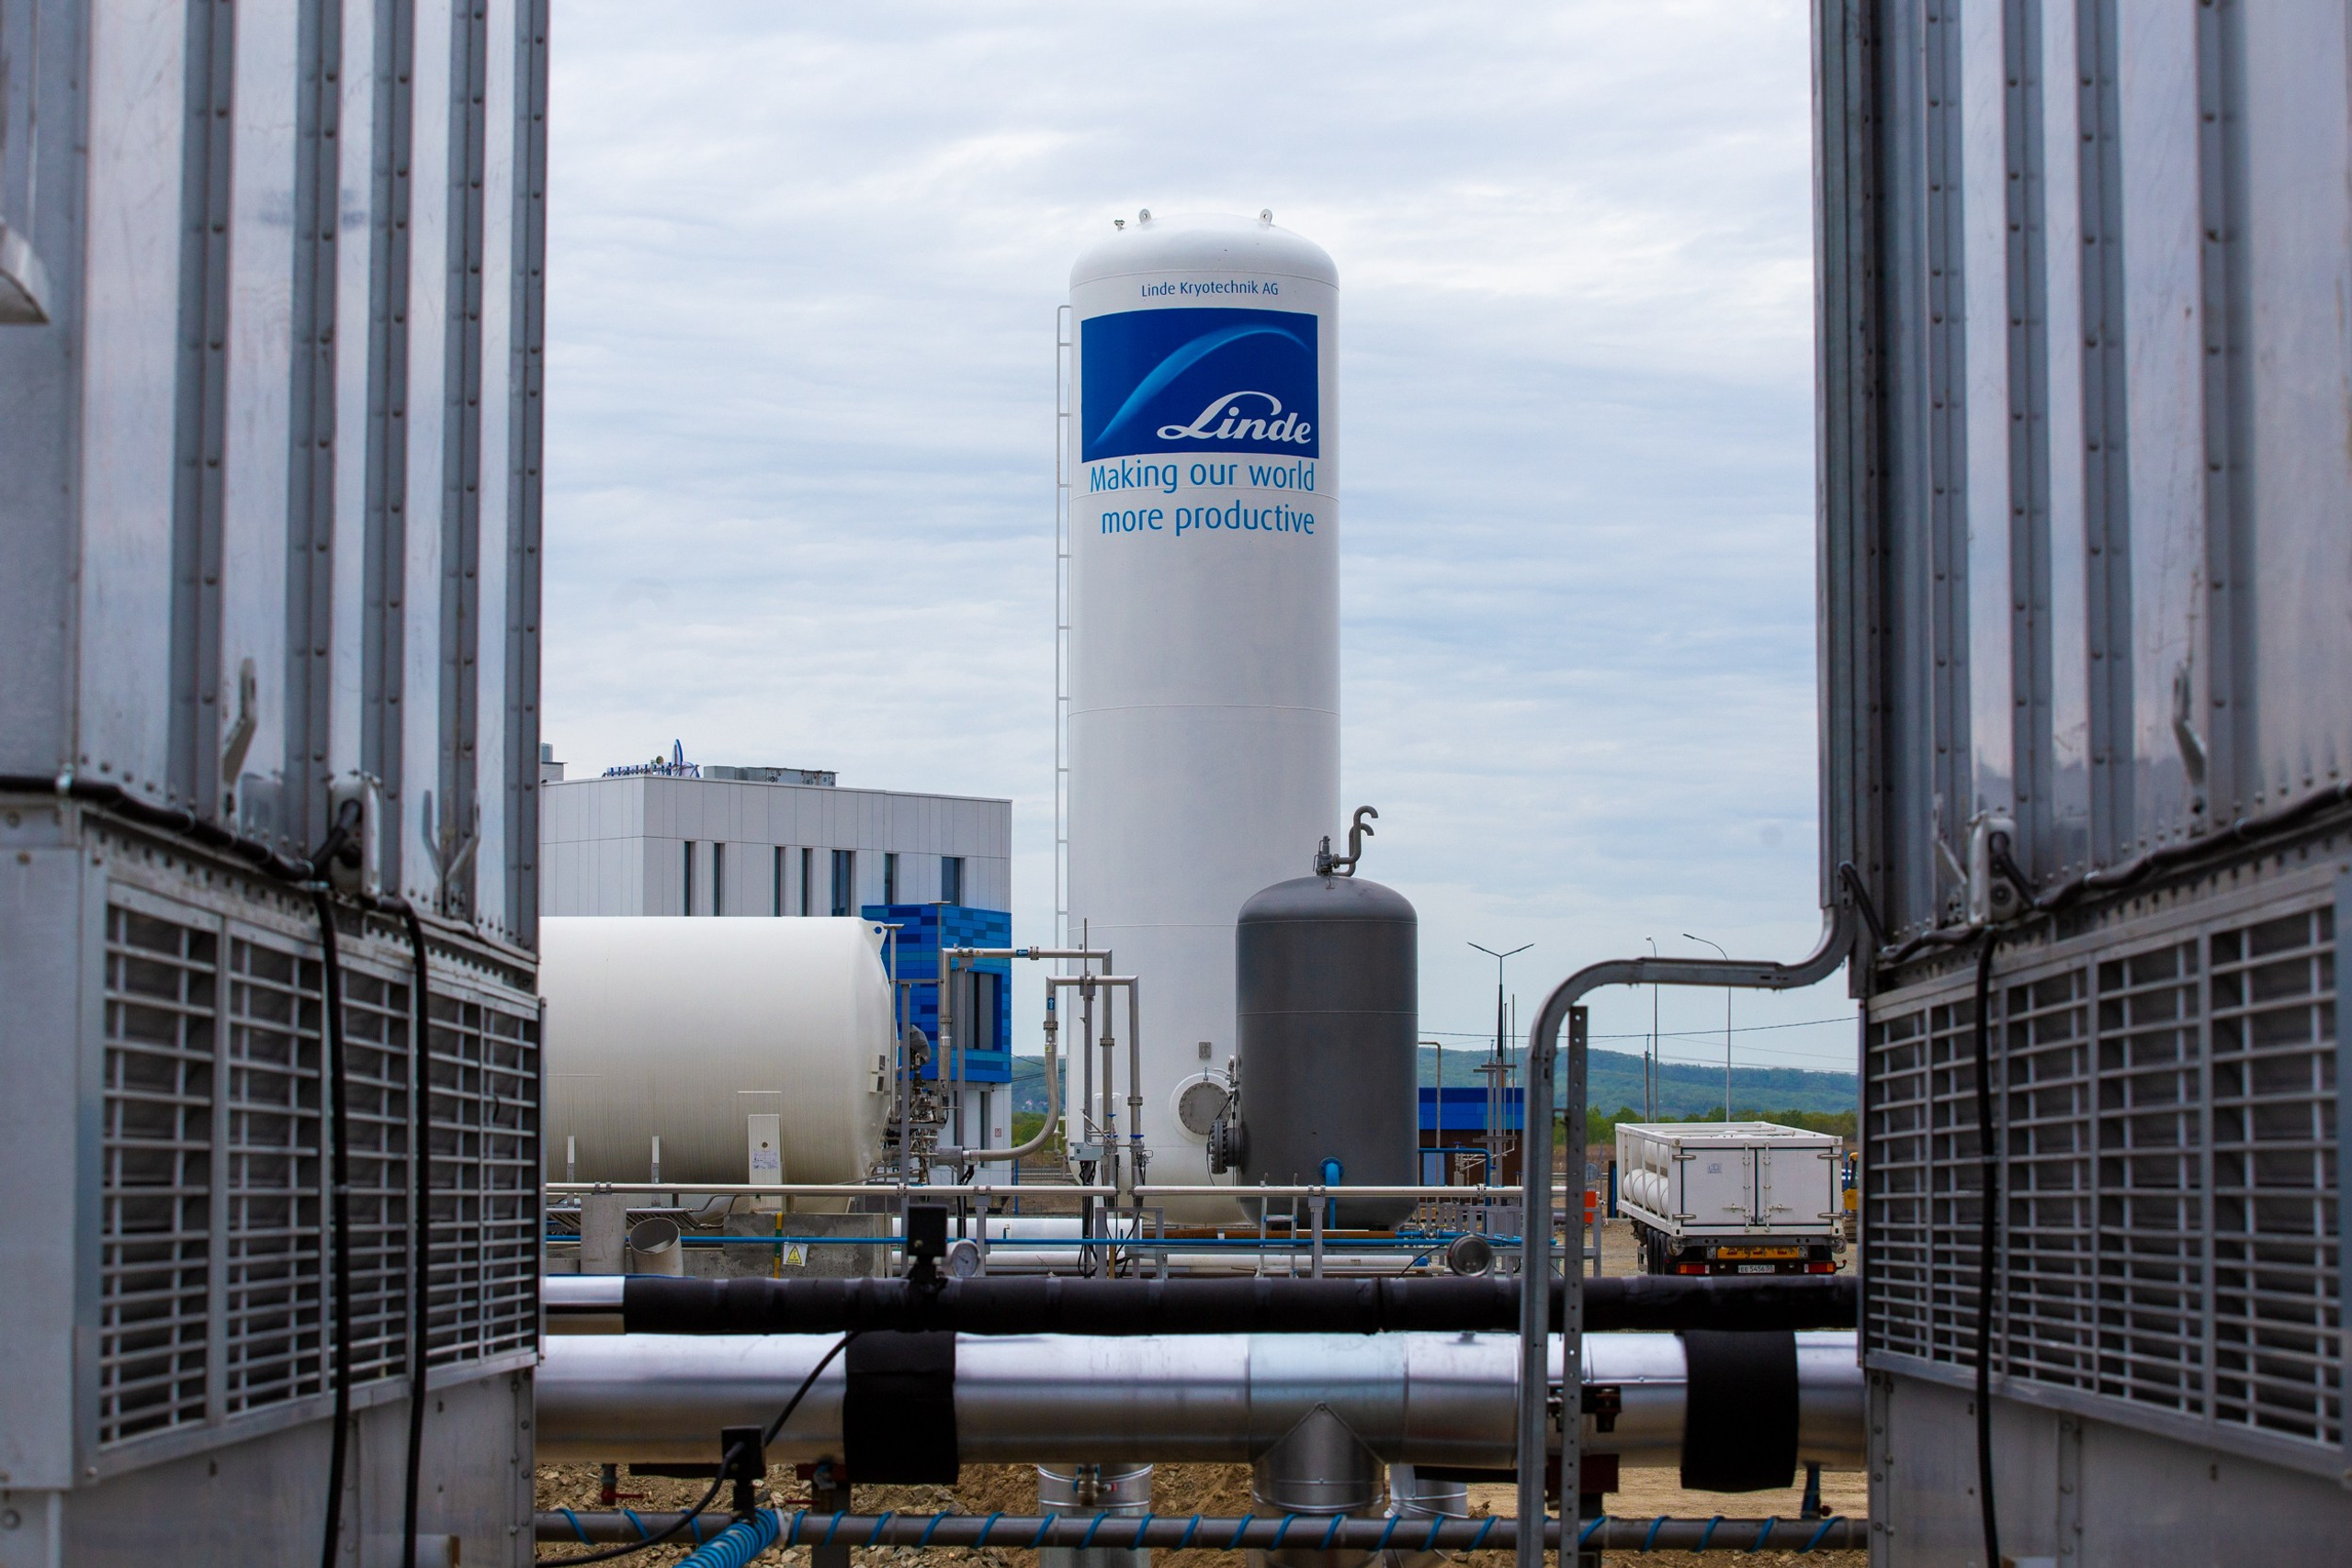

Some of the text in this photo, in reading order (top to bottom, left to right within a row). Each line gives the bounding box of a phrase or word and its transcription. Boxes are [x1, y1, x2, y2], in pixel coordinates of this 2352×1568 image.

[1141, 280, 1279, 297] Linde Kryotechnik AG
[1157, 390, 1311, 445] Linde
[1090, 458, 1315, 494] Making our world
[1102, 500, 1315, 537] more productive
